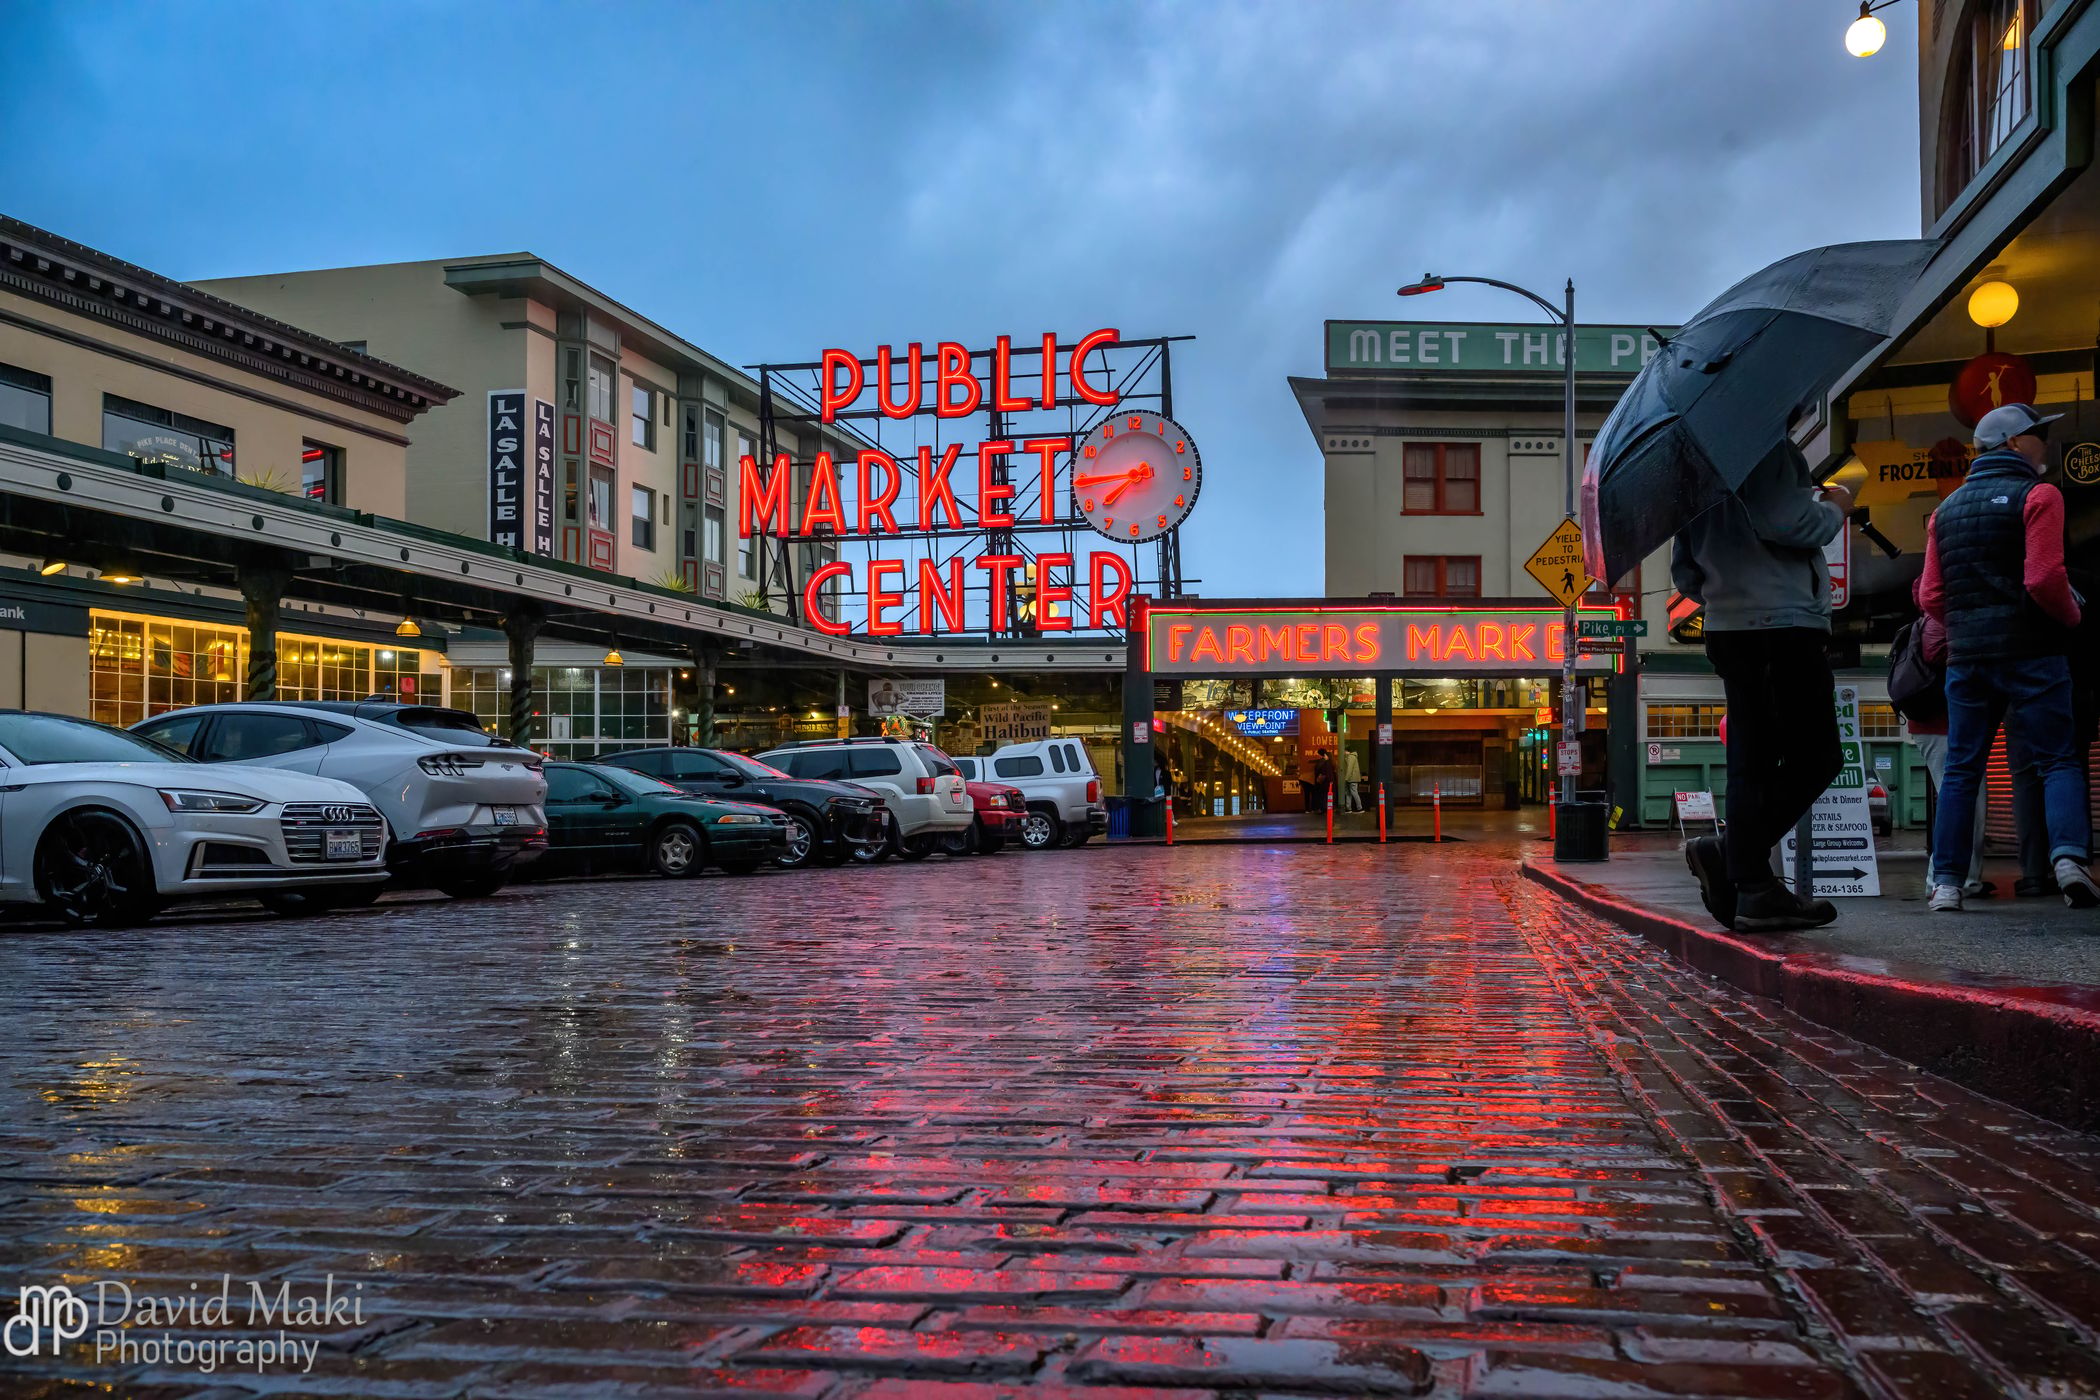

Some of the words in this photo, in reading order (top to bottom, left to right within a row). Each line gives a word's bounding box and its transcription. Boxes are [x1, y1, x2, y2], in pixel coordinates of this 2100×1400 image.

[1350, 329, 1467, 364] MEET
[1495, 332, 1576, 366] THE
[821, 328, 1120, 424] PUBLIC
[496, 400, 518, 430] LA
[538, 405, 551, 438] LA
[1128, 416, 1141, 430] 12
[1103, 425, 1114, 438] 11
[155, 436, 177, 447] PLACE
[1176, 440, 1184, 453] 2
[1084, 446, 1096, 458] 10
[495, 438, 518, 521] SALLE
[1183, 467, 1191, 480] 3
[538, 446, 550, 527] SALLE
[739, 437, 1072, 539] MARKET
[1085, 499, 1094, 512] 8
[1174, 494, 1184, 507] 4
[1104, 518, 1113, 529] 7
[1158, 515, 1166, 528] 5
[1130, 523, 1138, 536] 6
[1555, 533, 1582, 543] YIELD
[1562, 545, 1574, 553] TO
[1535, 555, 1584, 566] PEDESTRI
[803, 551, 1133, 636] CENTER
[1582, 621, 1609, 634] Pike
[1169, 624, 1378, 662] FARMERS
[1408, 623, 1590, 661] MARKE
[984, 712, 1009, 723] Wild
[1012, 711, 1048, 722] Pacific
[1228, 710, 1295, 721] WTERFRONT
[984, 723, 1049, 739] Halibut
[1840, 796, 1862, 804] Dinner
[1835, 823, 1868, 831] SEAFOOD
